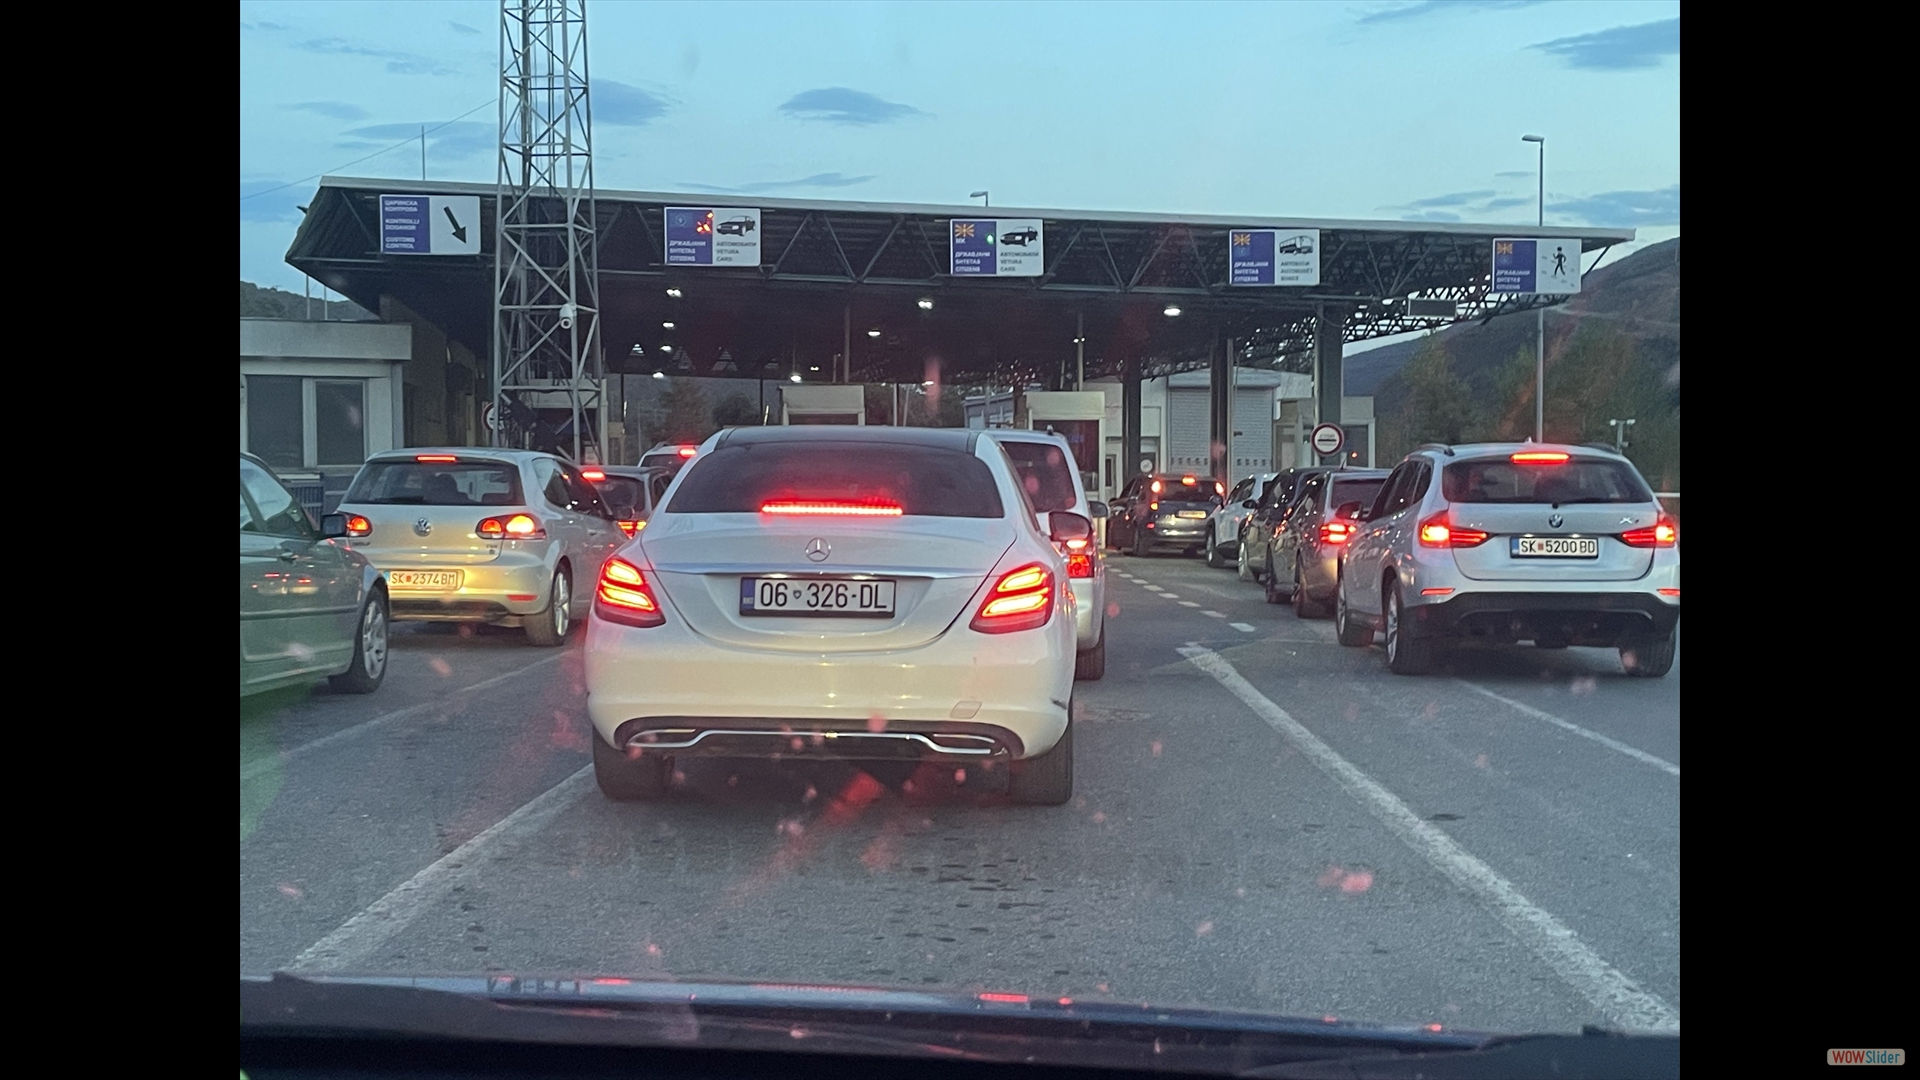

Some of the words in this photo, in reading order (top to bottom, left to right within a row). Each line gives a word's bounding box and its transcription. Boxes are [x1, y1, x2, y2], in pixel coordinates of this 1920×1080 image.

[1521, 540, 1536, 554] SK
[391, 573, 405, 585] SK
[760, 582, 789, 607] 06
